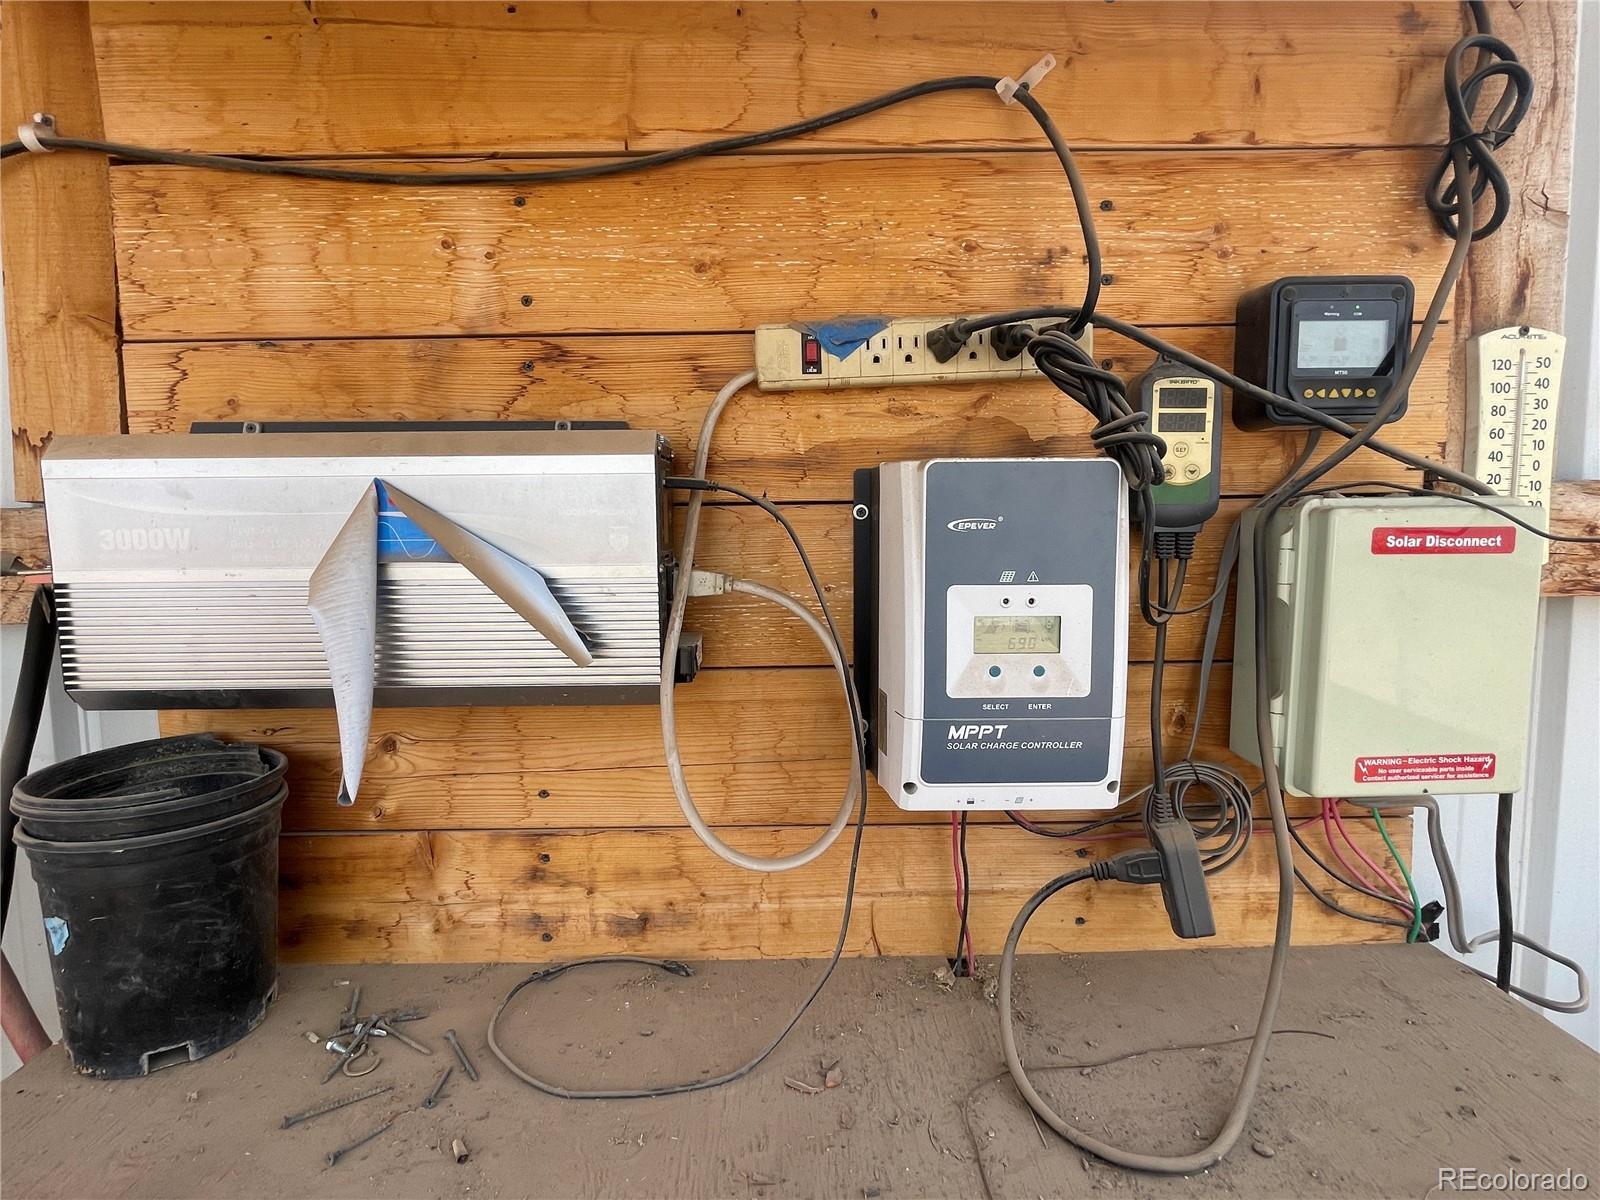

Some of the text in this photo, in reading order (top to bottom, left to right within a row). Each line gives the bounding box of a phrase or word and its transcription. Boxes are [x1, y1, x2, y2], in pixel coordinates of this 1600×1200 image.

[1491, 358, 1512, 371] 120
[1535, 356, 1552, 369] 50
[1490, 382, 1511, 394] 100
[1534, 377, 1550, 389] 40
[1532, 398, 1549, 410] 30
[1490, 405, 1507, 417] 80
[1531, 418, 1547, 431] 20
[1489, 427, 1505, 440] 60
[1532, 439, 1545, 451] 10
[1487, 450, 1504, 462] 40
[1532, 459, 1540, 471] 0
[1486, 473, 1502, 485] 20
[958, 522, 997, 530] EPEVER
[99, 527, 191, 551] 3000W
[1386, 535, 1502, 548] Solar Disconnect
[947, 724, 1009, 740] MPPT
[947, 741, 1083, 750] SOLAR CHARGE CONTROLLER
[1438, 755, 1462, 763] Shock
[1463, 755, 1490, 763] Hazard
